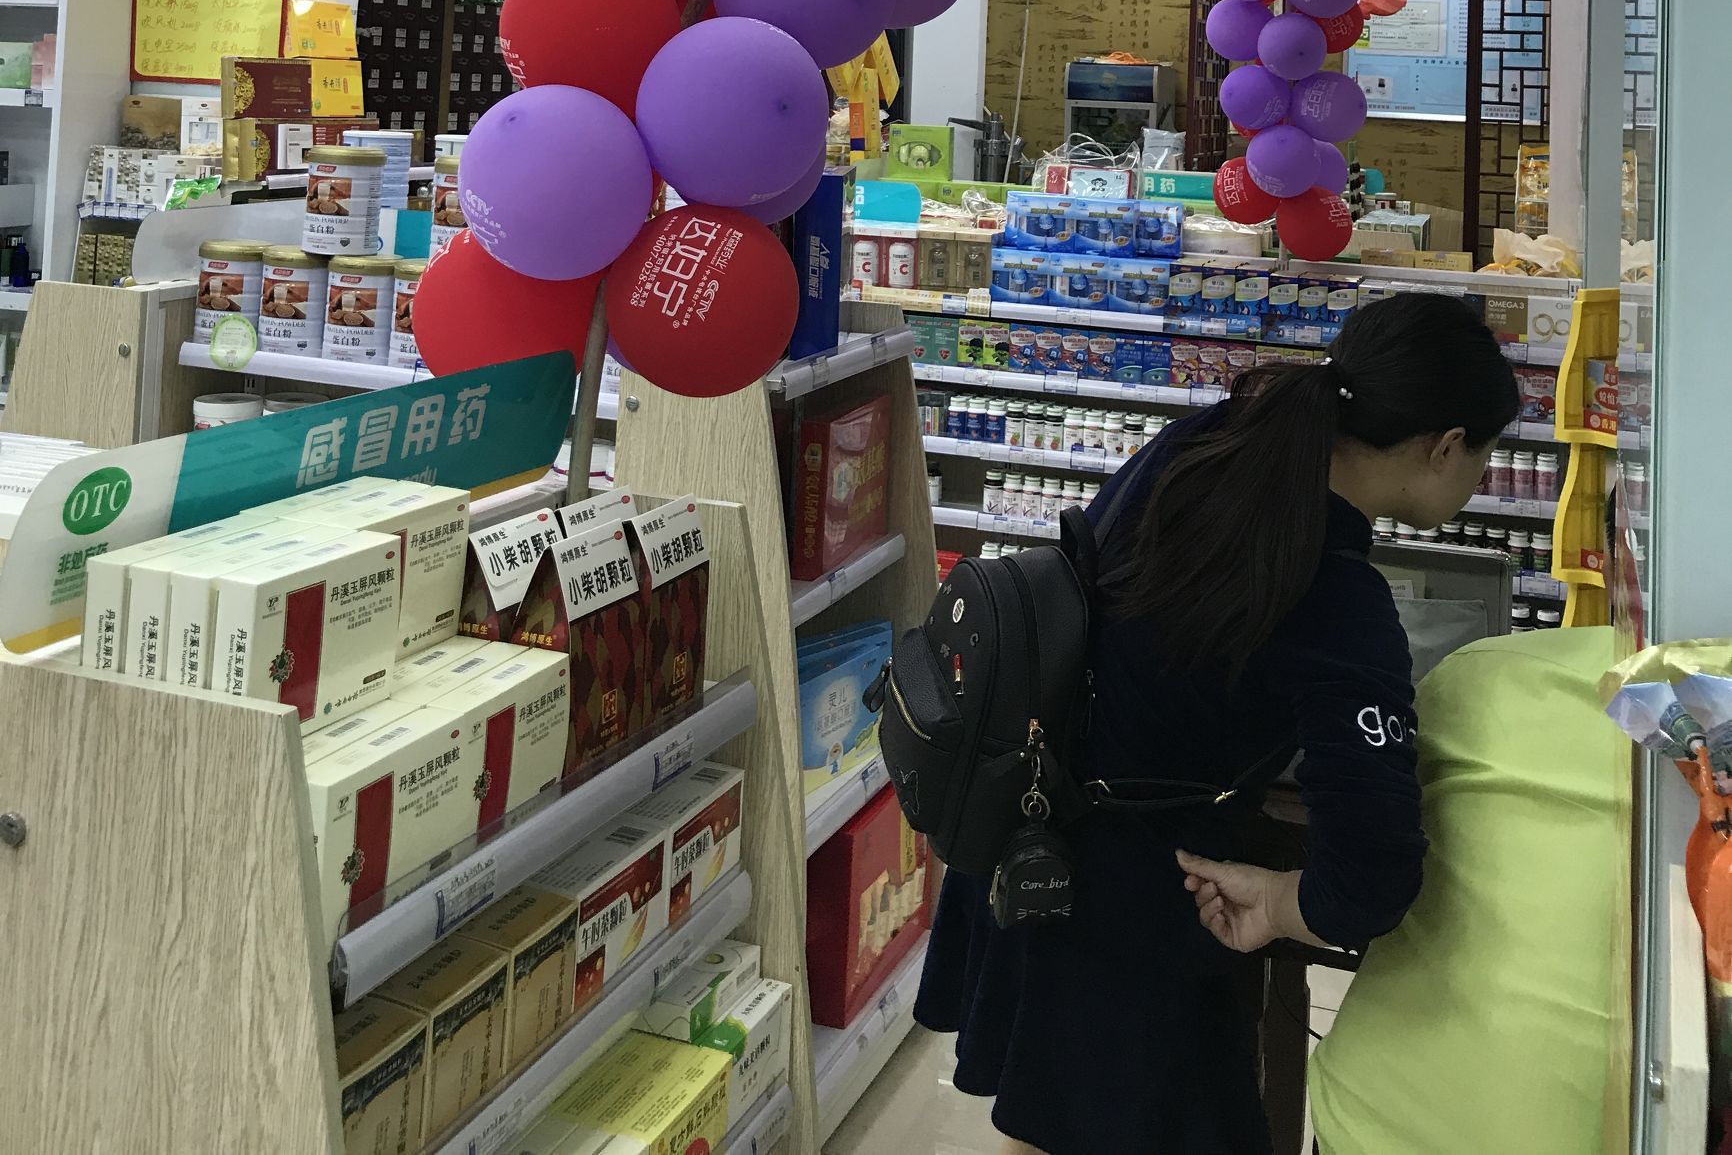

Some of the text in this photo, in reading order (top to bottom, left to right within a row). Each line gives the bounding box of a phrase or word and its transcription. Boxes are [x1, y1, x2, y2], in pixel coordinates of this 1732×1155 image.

[466, 189, 494, 216] CCTV
[1223, 167, 1241, 205] 达妇宁
[309, 224, 335, 235] 蛋白粉
[630, 234, 667, 307] 4007-028-788
[653, 217, 721, 317] 达妇宁
[696, 280, 719, 321] CCTV
[1488, 300, 1525, 309] OMEGA 3
[265, 327, 292, 338] 蛋白粉
[332, 336, 361, 347] 蛋白粉
[296, 383, 492, 489] 感冒用药
[70, 481, 128, 522] OTC
[568, 507, 597, 526] 鸿博原生
[409, 517, 465, 549] 丹溪玉屏风颗粒
[477, 529, 509, 548] 鸿博原生
[640, 518, 667, 537] 鸿博原生
[560, 544, 589, 565] 鸿博原生
[650, 526, 705, 575] 小柴胡颗粒
[330, 566, 396, 603] 丹溪玉屏风颗粒
[568, 555, 634, 606] 小柴胡颗粒
[102, 608, 116, 670] 丹溪玉屏风
[145, 615, 159, 679] 丹溪玉屏风
[187, 622, 200, 687] 丹溪玉屏风
[520, 631, 553, 646] 鸿博原生
[518, 683, 567, 723] 丹溪玉屏风颗粒
[398, 746, 461, 794] 丹溪玉屏风颗粒
[672, 829, 711, 877] 午时茶颗粒
[581, 897, 628, 951] 午时茶颗粒
